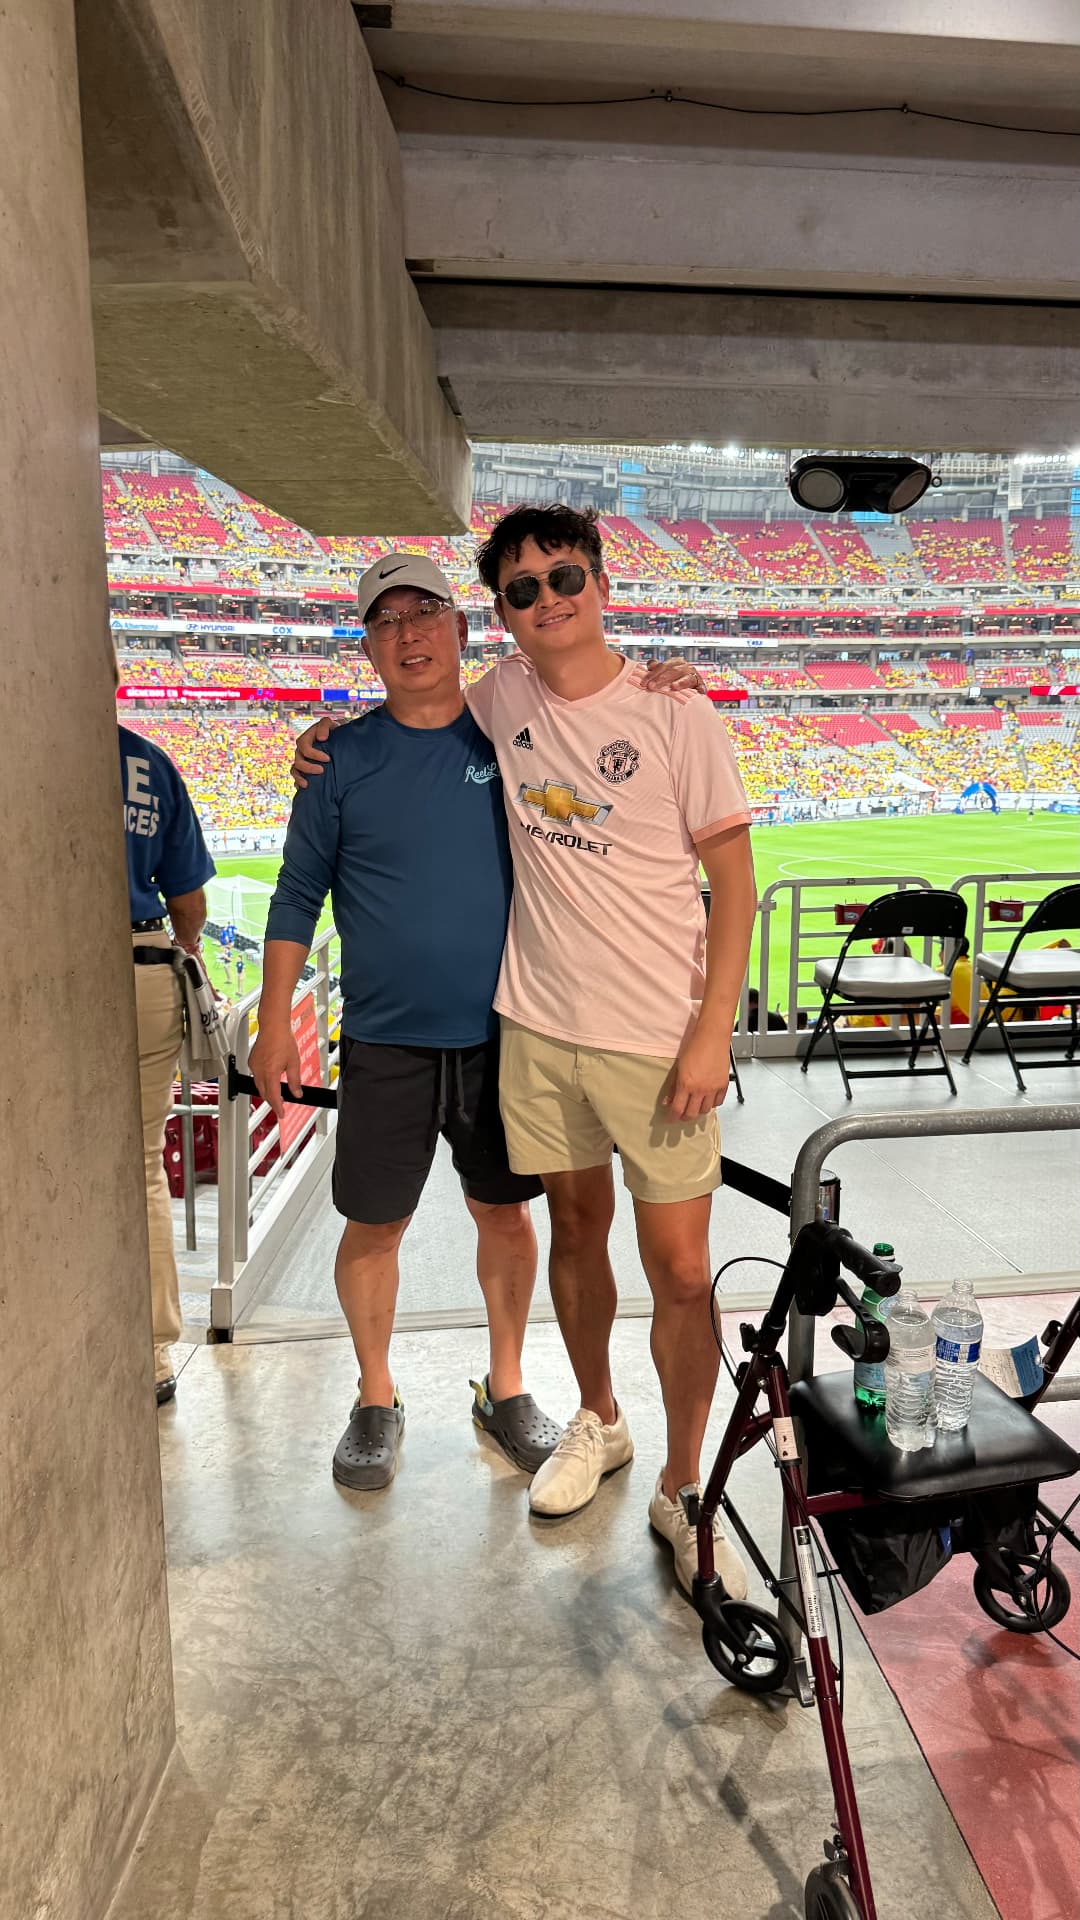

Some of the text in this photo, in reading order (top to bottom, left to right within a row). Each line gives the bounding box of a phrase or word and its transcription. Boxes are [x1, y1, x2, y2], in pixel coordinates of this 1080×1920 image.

[272, 626, 292, 634] COX
[512, 739, 534, 751] adidas
[519, 821, 613, 856] HEVROLET
